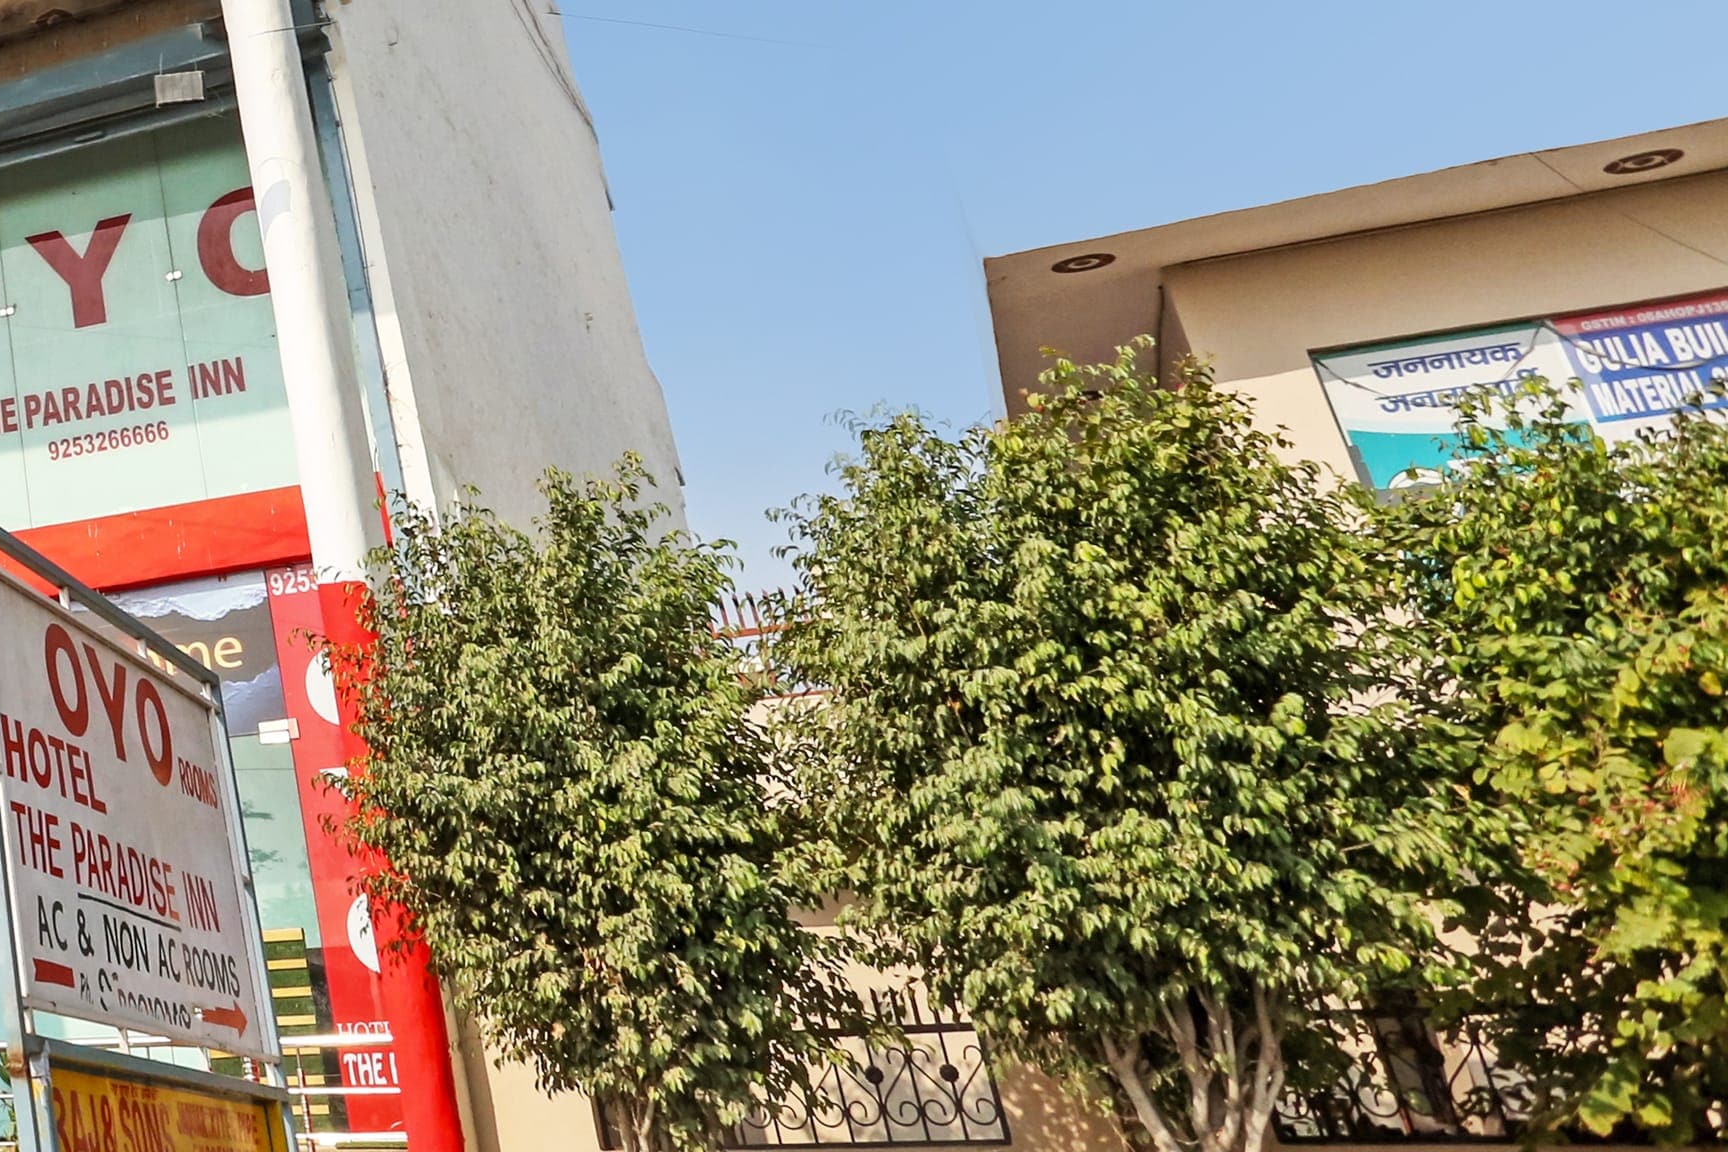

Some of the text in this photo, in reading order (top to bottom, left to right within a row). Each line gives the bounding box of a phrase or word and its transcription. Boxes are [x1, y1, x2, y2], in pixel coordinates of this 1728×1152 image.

[1580, 315, 1626, 331] GSTIN
[1368, 342, 1524, 379] जननायक
[1575, 332, 1670, 374] GULIA
[24, 369, 177, 429] PARADISE
[188, 356, 247, 400] INN
[1590, 370, 1718, 417] MATERIAL
[48, 421, 169, 461] 9253266666
[45, 623, 173, 787] OYO
[0, 713, 218, 815] HOTEL ROOMS
[10, 800, 221, 933] THE PARADISE INN
[37, 895, 241, 998] AC & NON AC ROOMS
[343, 1052, 388, 1086] THE
